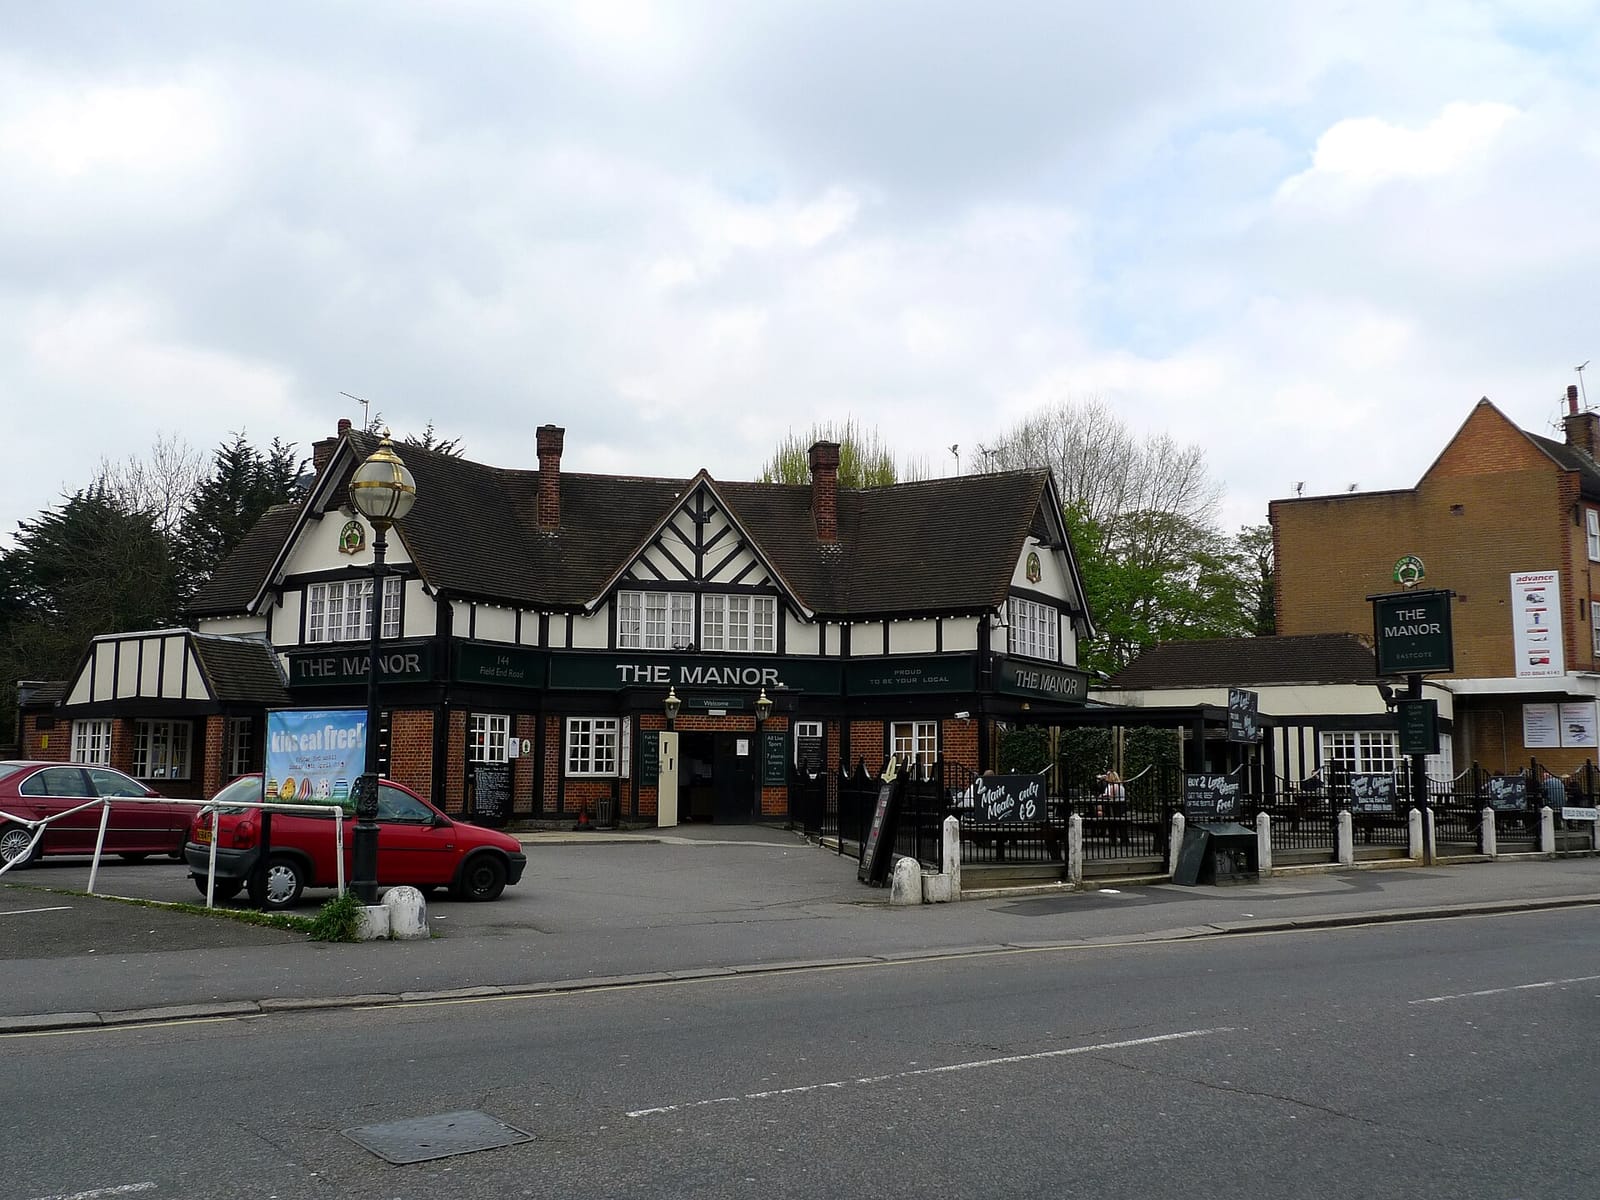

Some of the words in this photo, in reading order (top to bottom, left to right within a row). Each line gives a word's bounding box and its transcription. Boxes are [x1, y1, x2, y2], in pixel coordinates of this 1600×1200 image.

[1395, 608, 1427, 621] THE
[1384, 623, 1442, 638] MANOR
[496, 655, 510, 666] 144
[1395, 651, 1433, 660] EASTCOTE
[297, 658, 337, 678] THE
[342, 653, 421, 676] MANOR
[480, 665, 495, 677] Field
[496, 667, 508, 678] End
[508, 668, 524, 679] Road
[616, 664, 671, 684] THE
[680, 666, 779, 686] MANOR
[895, 677, 918, 685] YOUR
[922, 676, 950, 684] LOCAL
[1015, 669, 1039, 690] THE
[1039, 673, 1079, 696] MANOR
[703, 699, 730, 707] Welcome
[271, 730, 298, 753] kids
[300, 729, 323, 752] eat
[975, 777, 987, 795] 2
[1187, 777, 1199, 787] BUY
[1200, 775, 1207, 788] 2
[981, 785, 1005, 808] Main
[1018, 781, 1039, 801] only
[987, 793, 1015, 820] Meals
